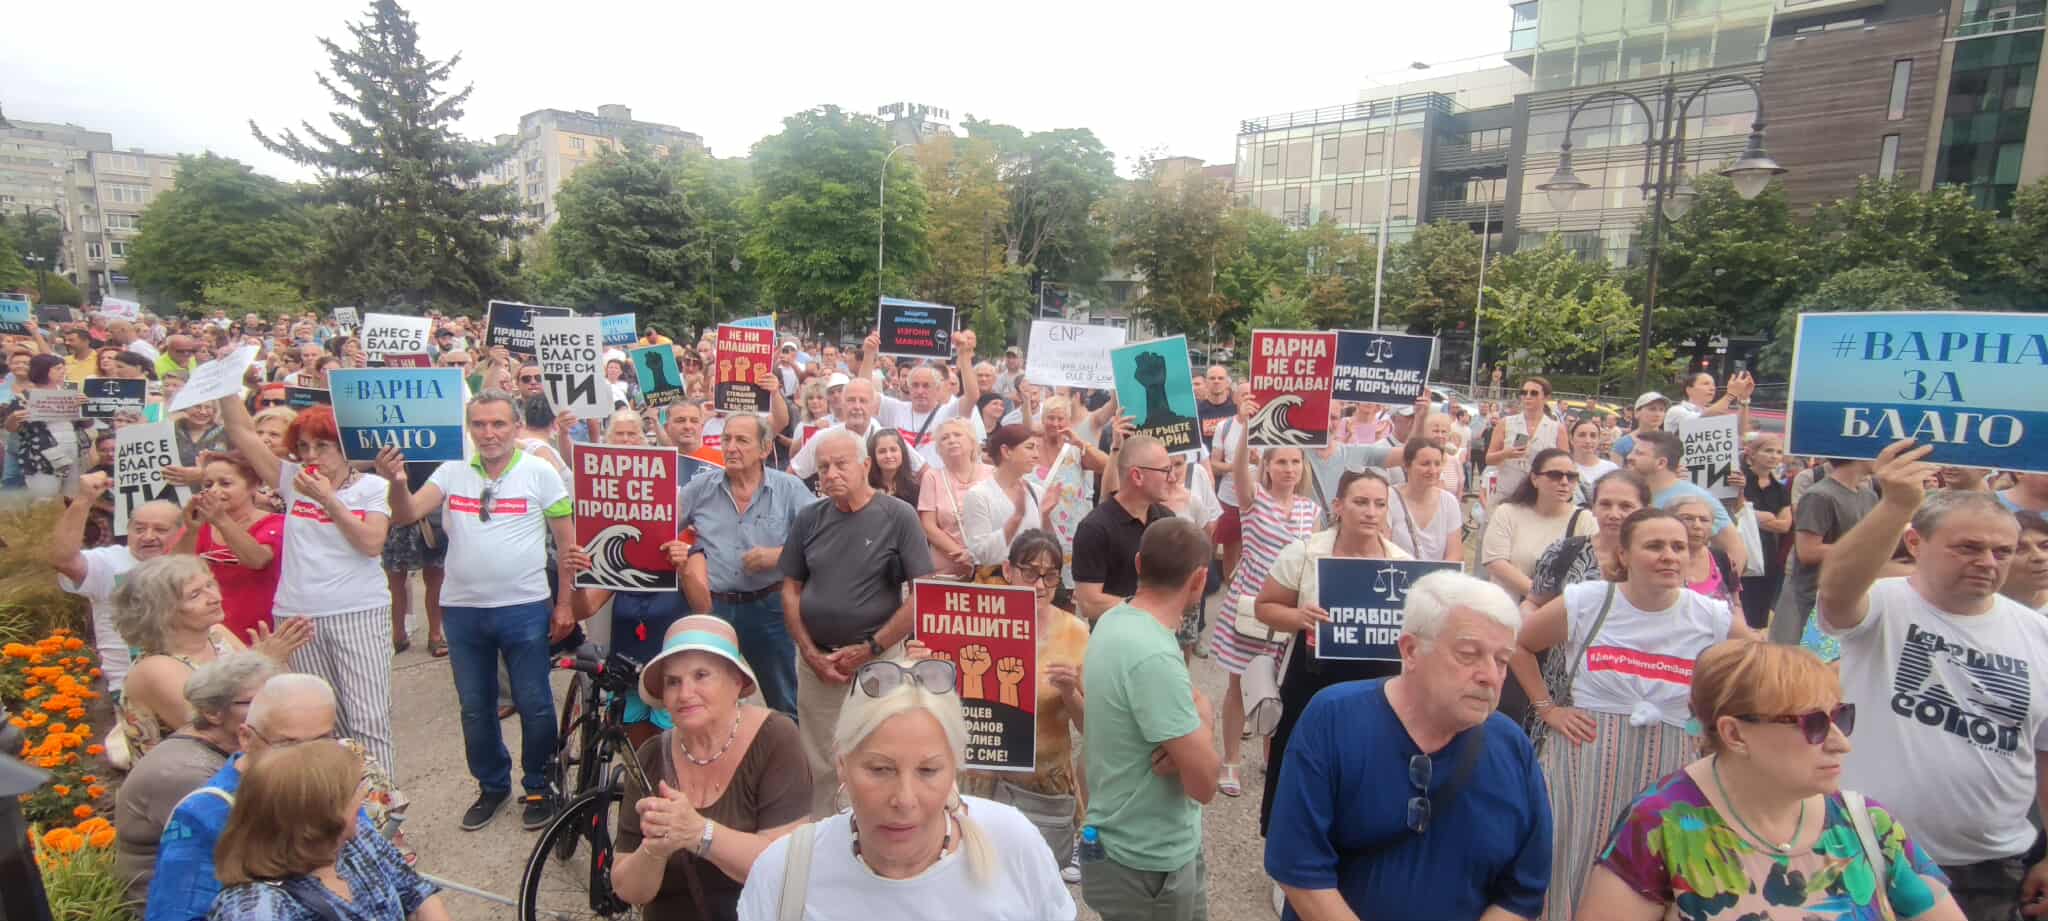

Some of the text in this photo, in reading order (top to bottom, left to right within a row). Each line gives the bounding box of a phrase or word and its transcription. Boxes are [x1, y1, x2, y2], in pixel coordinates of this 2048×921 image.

[367, 327, 423, 339] ДНЕС Е
[494, 337, 508, 345] НЕ
[540, 334, 581, 346] ДНЕС
[586, 334, 594, 346] Е
[729, 330, 760, 342] НЕ НИ
[367, 338, 421, 351] БЛАГО
[719, 341, 771, 355] ПЛАШИТЕ!
[1261, 337, 1326, 357] ВАРНА
[1832, 331, 2048, 365] #ВАРНА
[542, 348, 596, 361] БЛАГО
[542, 363, 596, 373] УТРЕ СИ
[1267, 358, 1316, 375] НЕ СЕ
[1334, 365, 1423, 384] ПРАВОСЪДИЕ,
[344, 379, 444, 400] #ВАРНА
[544, 374, 597, 405] ТИ
[1253, 376, 1329, 392] ПРОДАВА!
[1335, 379, 1420, 396] НЕ ПОРЪЧКИ!
[1899, 369, 1965, 402] ЗА
[376, 404, 406, 424] ЗА
[1156, 422, 1191, 435] РЪЦЕТЕ
[1685, 428, 1733, 444] ДНЕС Е
[1840, 407, 2025, 448] БЛАГО
[356, 428, 437, 449] БЛАГО
[119, 440, 169, 458] ДНЕС Е
[1686, 440, 1733, 455] БЛАГО
[119, 455, 172, 472] БЛАГО
[584, 453, 667, 479] ВАРНА
[1686, 453, 1732, 464] УТРЕ СИ
[119, 472, 147, 484] УТРЕ
[1686, 462, 1731, 488] ТИ
[592, 478, 654, 501] НЕ СЕ
[578, 500, 673, 522] ПРОДАВА!
[945, 592, 1006, 615] НЕ НИ
[922, 614, 1031, 640] ПЛАШИТЕ!
[1334, 626, 1399, 645] НЕ ПОР
[962, 706, 993, 719] ОЦЕВ
[966, 721, 1004, 733] ФАНОВ
[978, 749, 1008, 762] СМЕ!
